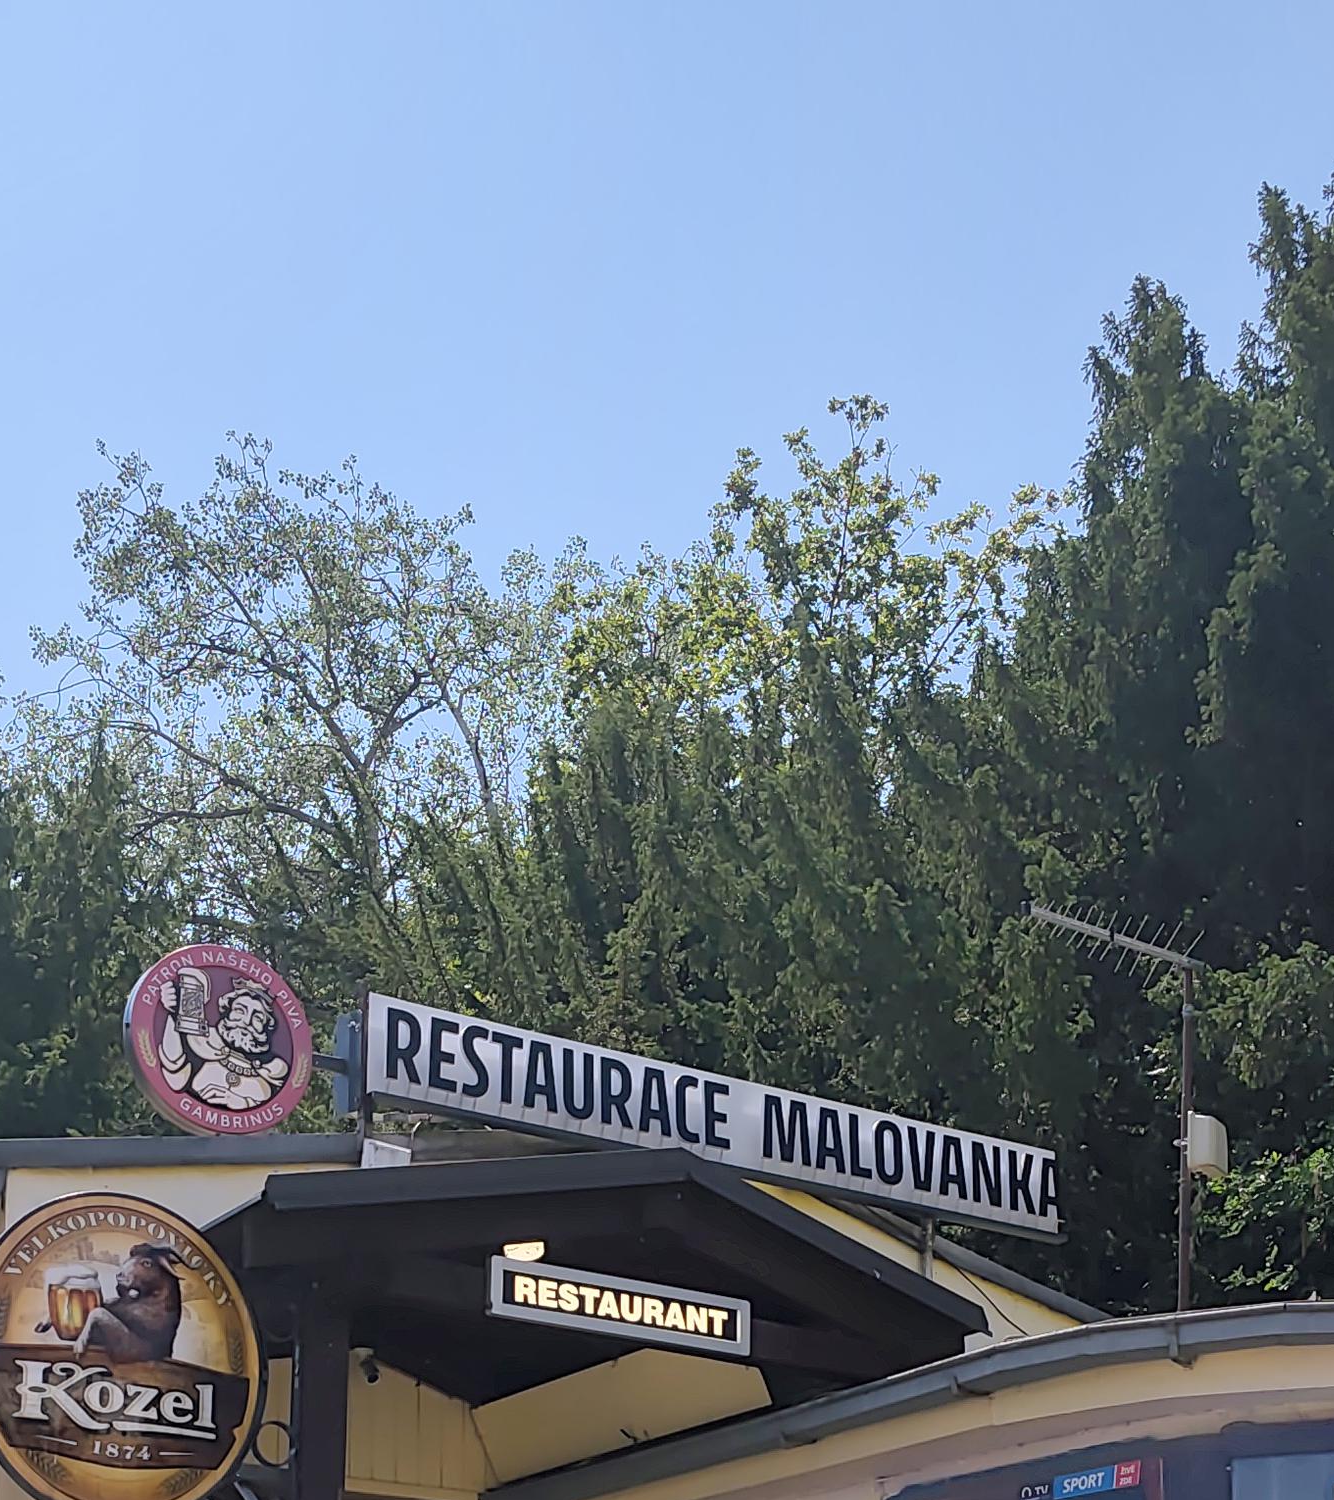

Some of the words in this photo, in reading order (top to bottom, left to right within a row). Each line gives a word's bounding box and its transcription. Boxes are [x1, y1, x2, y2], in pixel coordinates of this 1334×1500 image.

[142, 956, 194, 1006] PATRON
[202, 951, 273, 986] NAŠEHO
[276, 990, 303, 1030] PIVA
[179, 1099, 284, 1128] GAMBRINUS
[386, 1006, 731, 1149] RESTAURACE
[762, 1093, 1058, 1218] MALOVANKA
[514, 1275, 729, 1337] RESTAURANT
[11, 1359, 217, 1433] Kozel
[92, 1440, 151, 1461] 1874
[1062, 1472, 1105, 1494] SPORT
